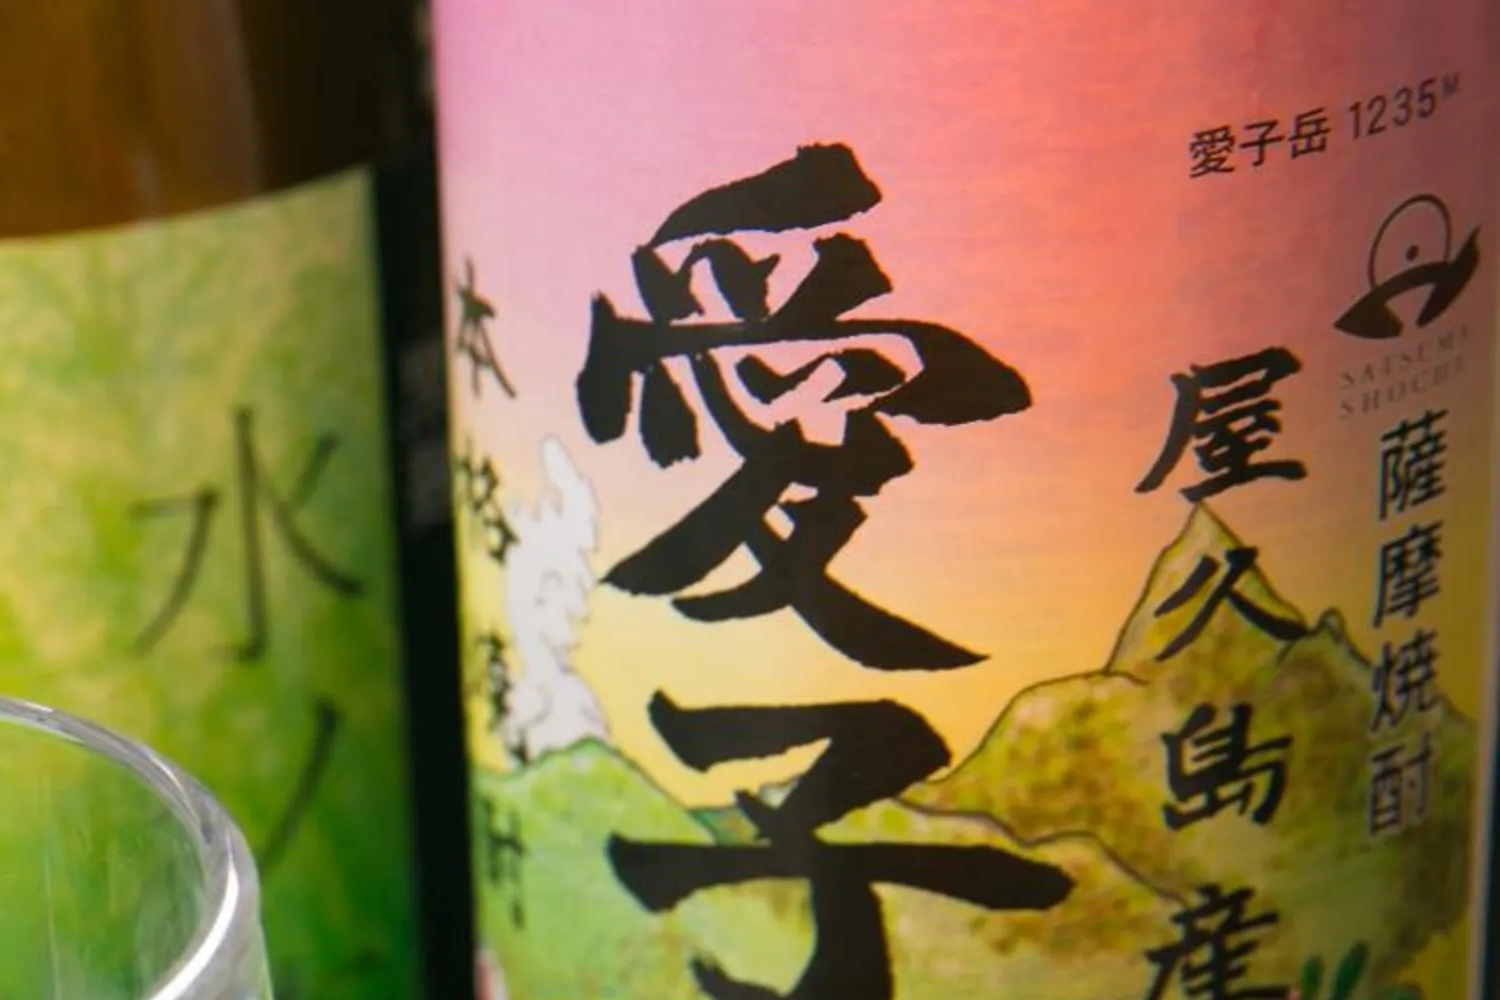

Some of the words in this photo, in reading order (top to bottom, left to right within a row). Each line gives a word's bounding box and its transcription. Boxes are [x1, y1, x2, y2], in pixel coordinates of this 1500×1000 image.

[1189, 107, 1332, 179] 愛子岳
[1368, 407, 1450, 838] 薩摩焼酎
